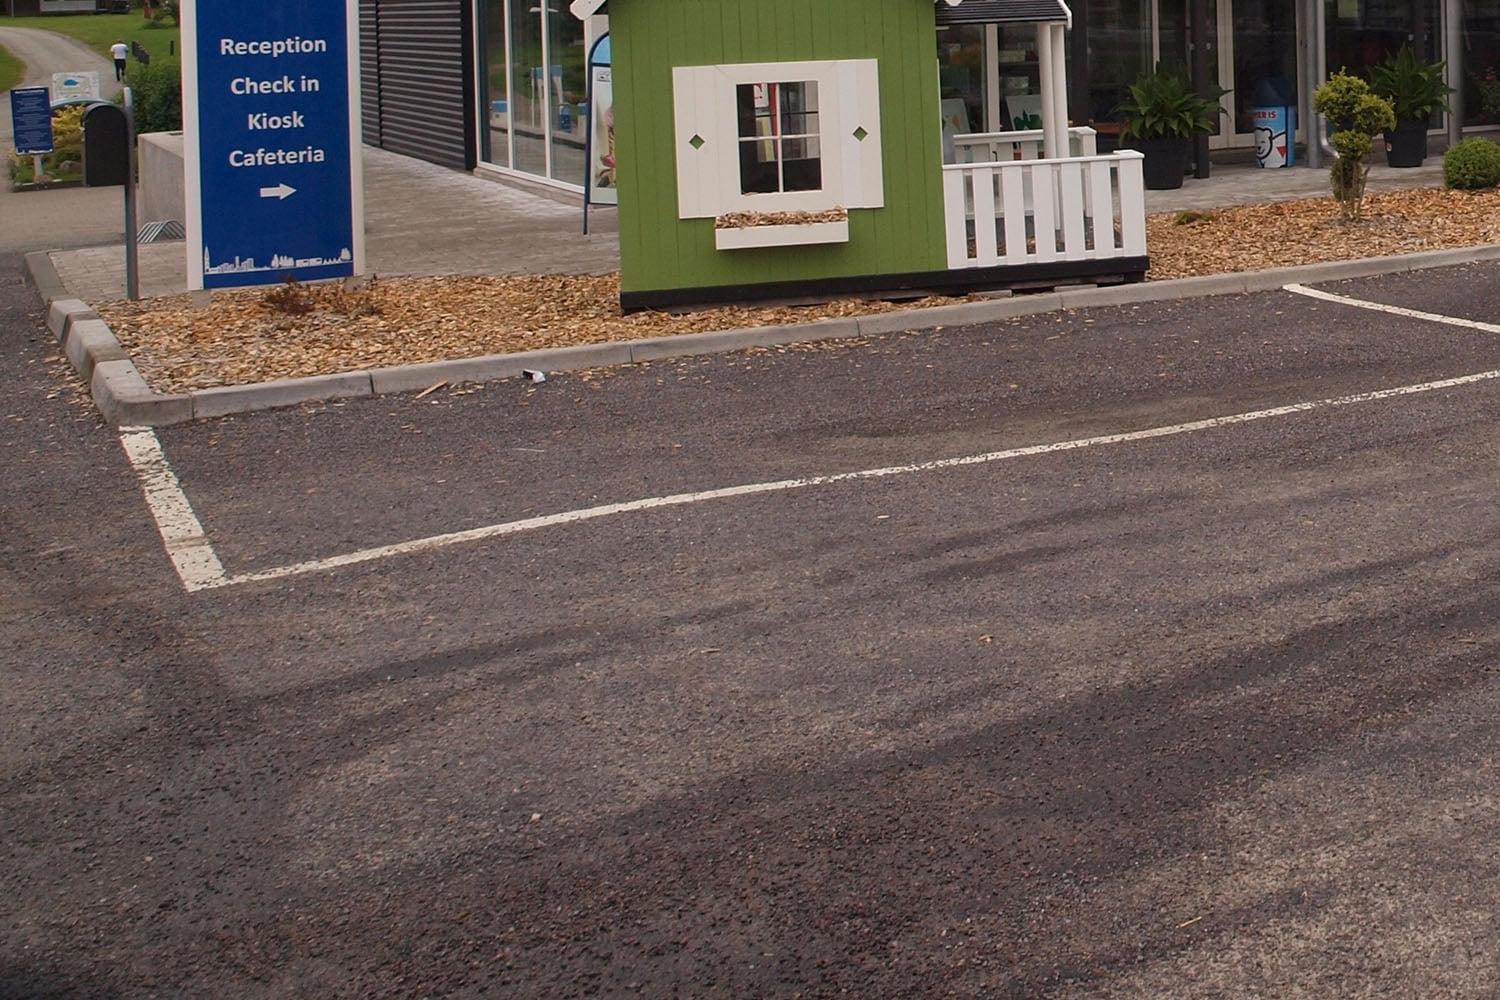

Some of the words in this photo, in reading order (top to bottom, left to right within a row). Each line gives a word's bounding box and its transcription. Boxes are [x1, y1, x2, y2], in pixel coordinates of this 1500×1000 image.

[220, 36, 327, 58] Reception
[230, 76, 295, 95] Check
[301, 75, 320, 92] in
[248, 111, 305, 130] Kiosk
[228, 146, 325, 167] Cafeteria
